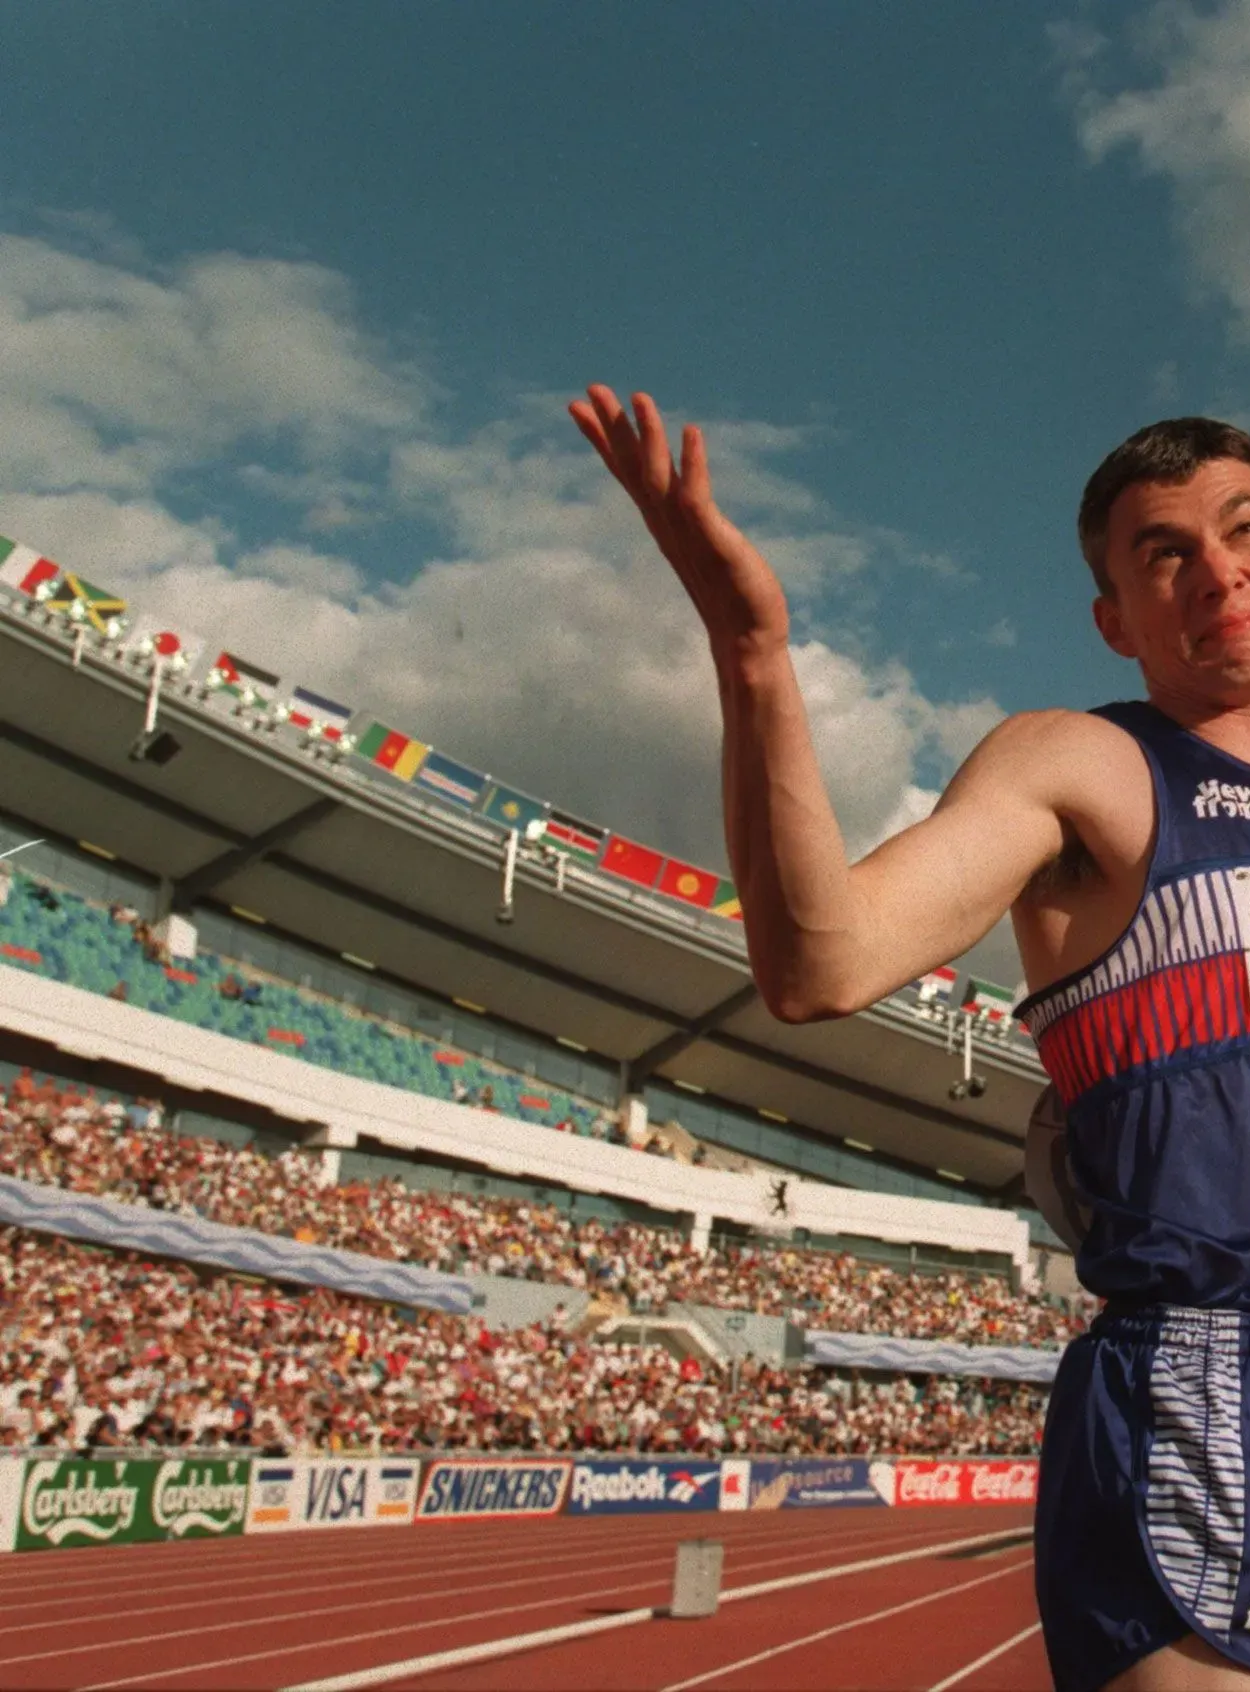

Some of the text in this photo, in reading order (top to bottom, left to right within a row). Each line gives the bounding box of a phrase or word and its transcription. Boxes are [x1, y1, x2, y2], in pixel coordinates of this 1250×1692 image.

[22, 1460, 140, 1535] Carlsberg
[152, 1460, 248, 1528] Carlsberg
[306, 1464, 367, 1521] VISA
[423, 1466, 564, 1514] SNICKERS
[571, 1466, 667, 1510] Reebok
